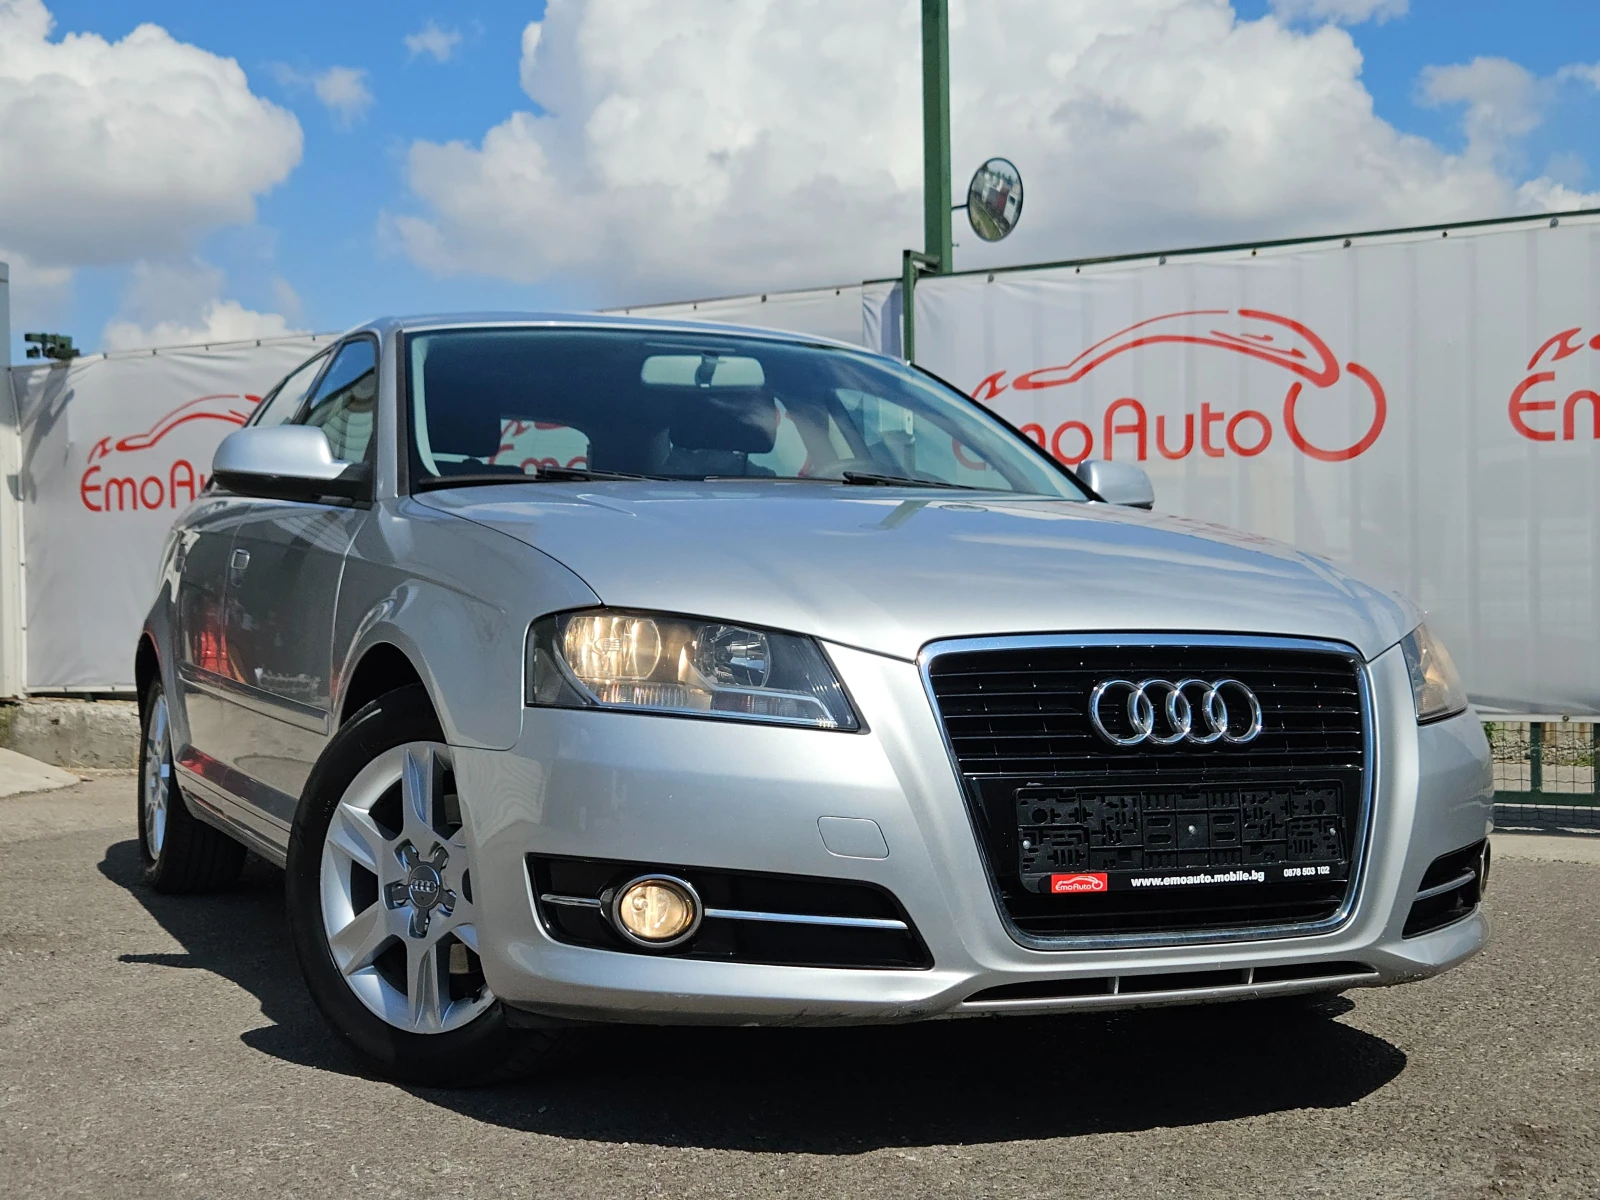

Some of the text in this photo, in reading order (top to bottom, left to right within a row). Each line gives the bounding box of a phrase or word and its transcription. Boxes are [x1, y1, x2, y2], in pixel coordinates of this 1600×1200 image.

[81, 459, 207, 512] EmoA
[1131, 870, 1265, 887] www.emoauto.mobile.bg
[1302, 867, 1316, 876] 503
[1317, 866, 1330, 875] 102
